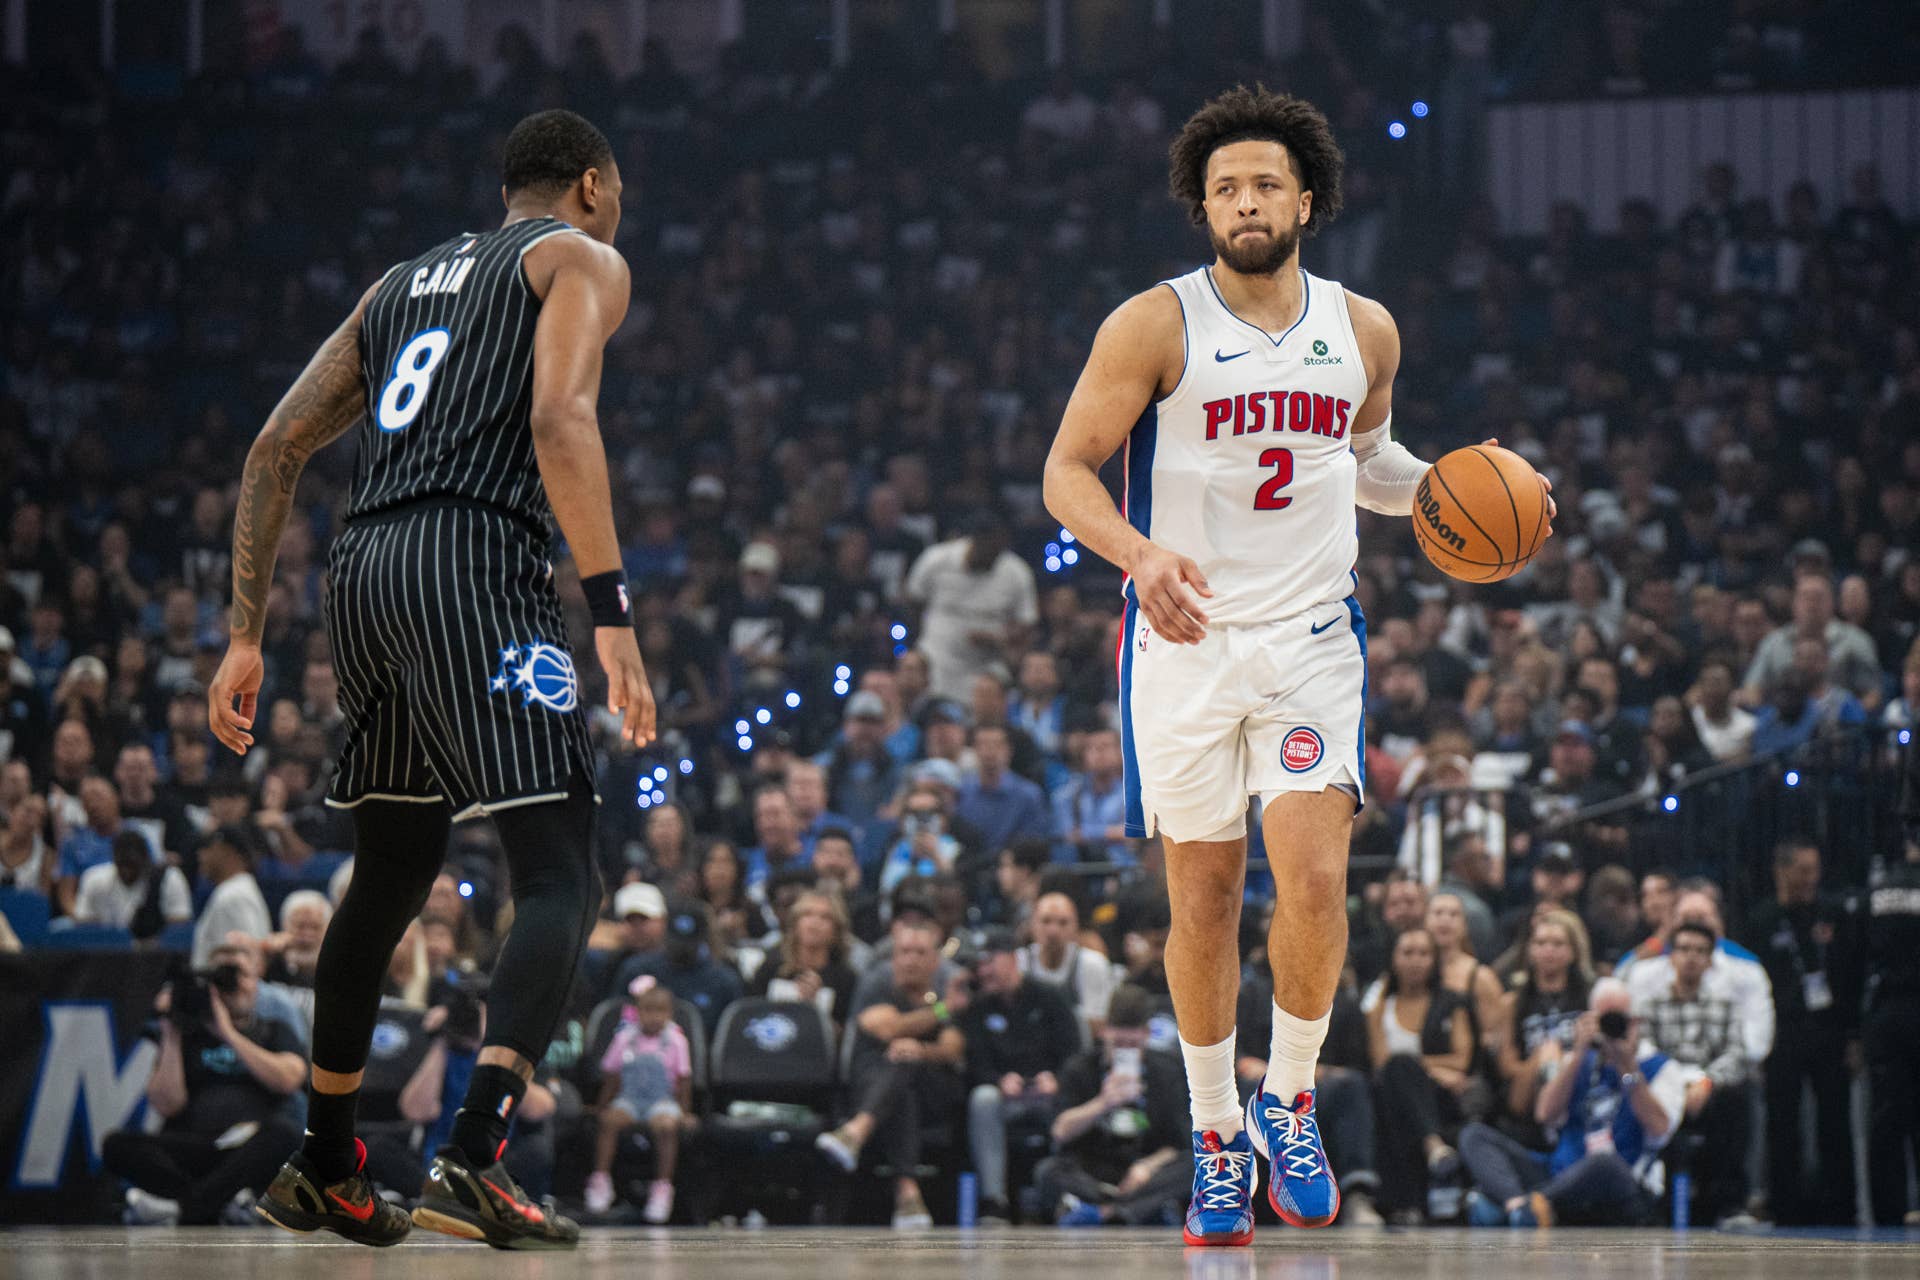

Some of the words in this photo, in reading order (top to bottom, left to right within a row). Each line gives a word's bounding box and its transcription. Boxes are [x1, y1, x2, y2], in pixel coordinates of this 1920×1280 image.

[410, 257, 475, 298] CAIN
[376, 326, 451, 433] 8
[1303, 356, 1343, 366] StockX
[1203, 391, 1351, 441] PISTONS
[1253, 447, 1294, 511] 2
[1417, 474, 1466, 553] Wilson
[1286, 749, 1314, 759] PISTONS
[1288, 741, 1315, 751] DETROIT
